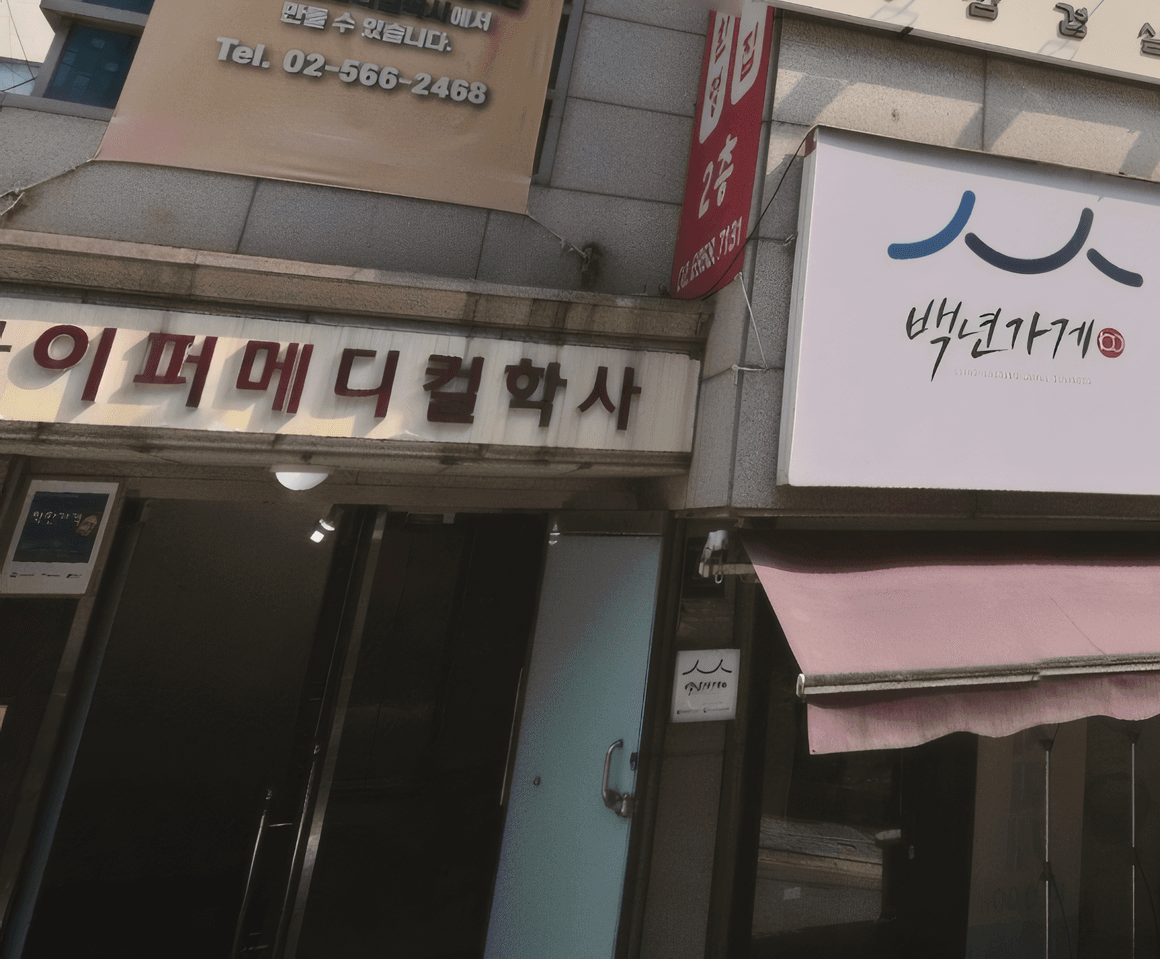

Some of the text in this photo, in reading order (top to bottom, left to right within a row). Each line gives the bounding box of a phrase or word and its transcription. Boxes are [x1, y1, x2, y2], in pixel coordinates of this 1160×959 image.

[332, 11, 355, 34] 수
[216, 37, 488, 105] Tel. 02-566-2468
[906, 297, 1094, 381] 백년가게
